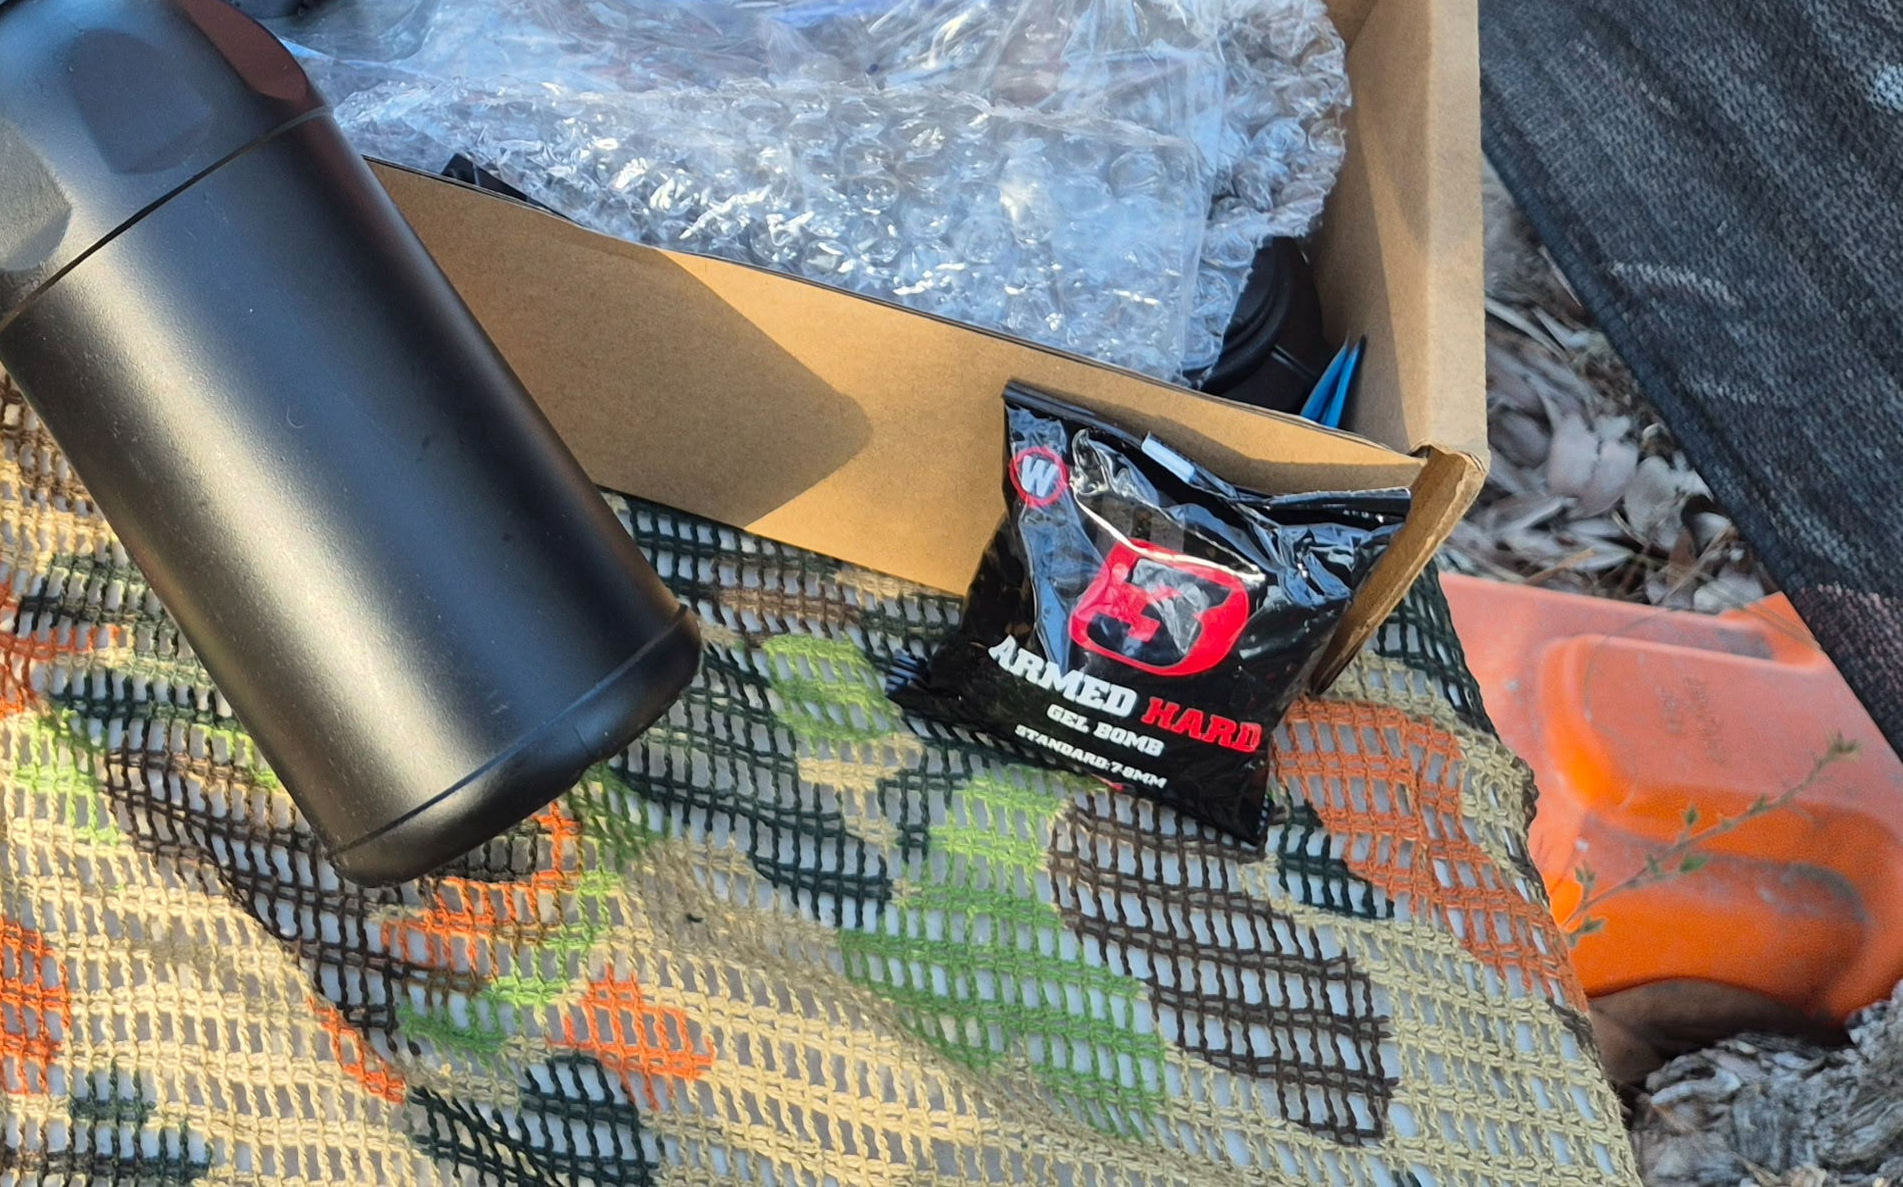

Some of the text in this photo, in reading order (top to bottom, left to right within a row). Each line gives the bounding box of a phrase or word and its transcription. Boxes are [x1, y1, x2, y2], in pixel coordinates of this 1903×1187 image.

[1019, 454, 1060, 498] W
[988, 634, 1263, 753] ARMED HARD
[1046, 703, 1166, 758] GEL BOMB
